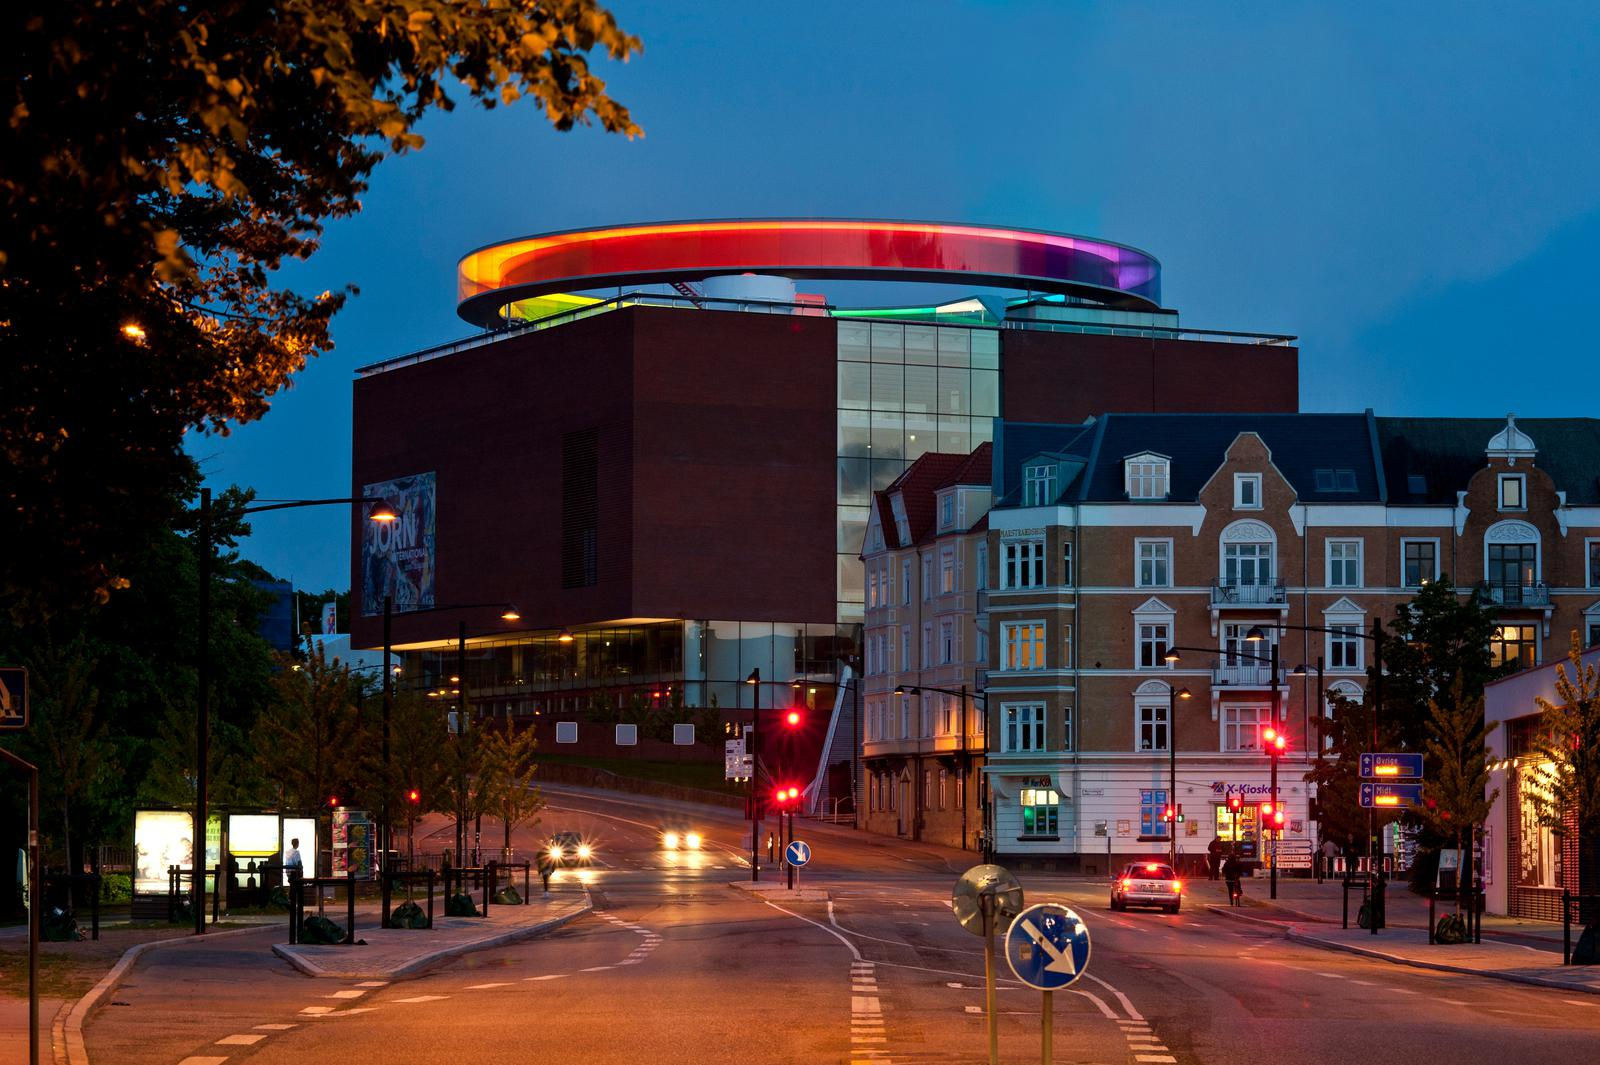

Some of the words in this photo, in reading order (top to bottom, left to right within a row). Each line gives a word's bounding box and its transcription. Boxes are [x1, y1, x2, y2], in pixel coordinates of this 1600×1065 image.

[368, 512, 417, 554] JORN
[1376, 756, 1398, 766] Øvrige
[1364, 767, 1370, 775] P
[1376, 786, 1392, 795] Midt
[1364, 796, 1370, 804] P
